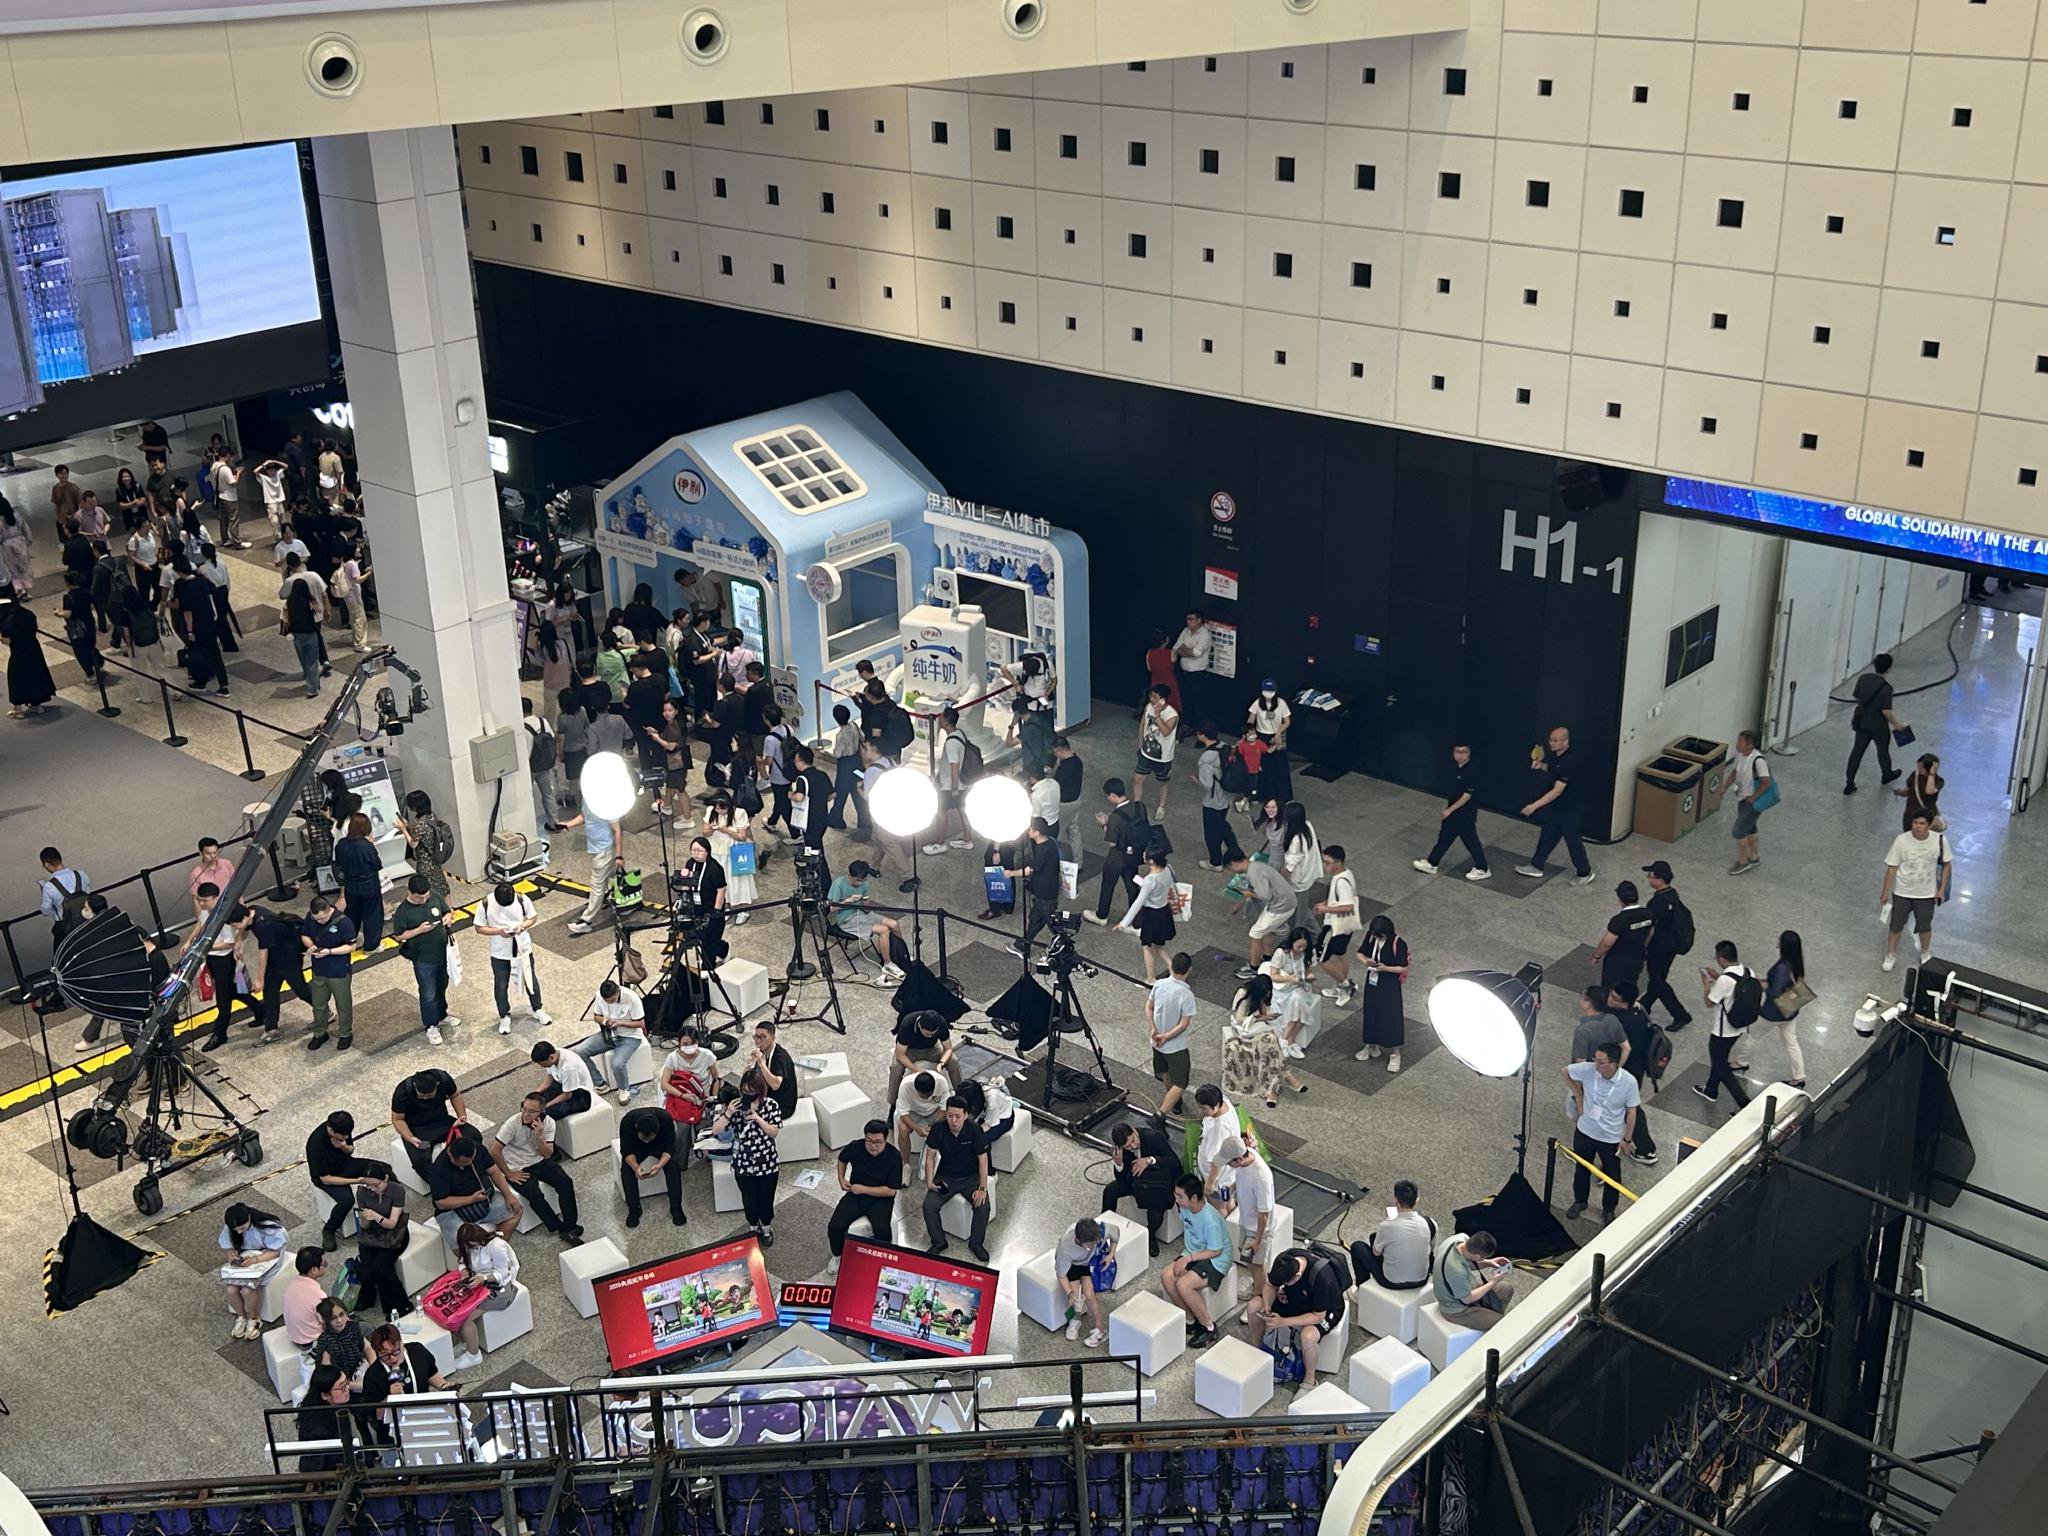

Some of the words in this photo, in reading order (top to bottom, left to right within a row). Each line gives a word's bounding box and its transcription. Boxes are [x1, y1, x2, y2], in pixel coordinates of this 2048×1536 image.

[677, 477, 700, 497] 伊利
[1845, 507, 1898, 528] GLOBAL
[1901, 517, 1982, 543] SOLIDARITY
[1985, 532, 2000, 547] IN
[2004, 535, 2031, 553] THE
[913, 658, 957, 685] 纯牛奶
[784, 1286, 832, 1304] 00:00
